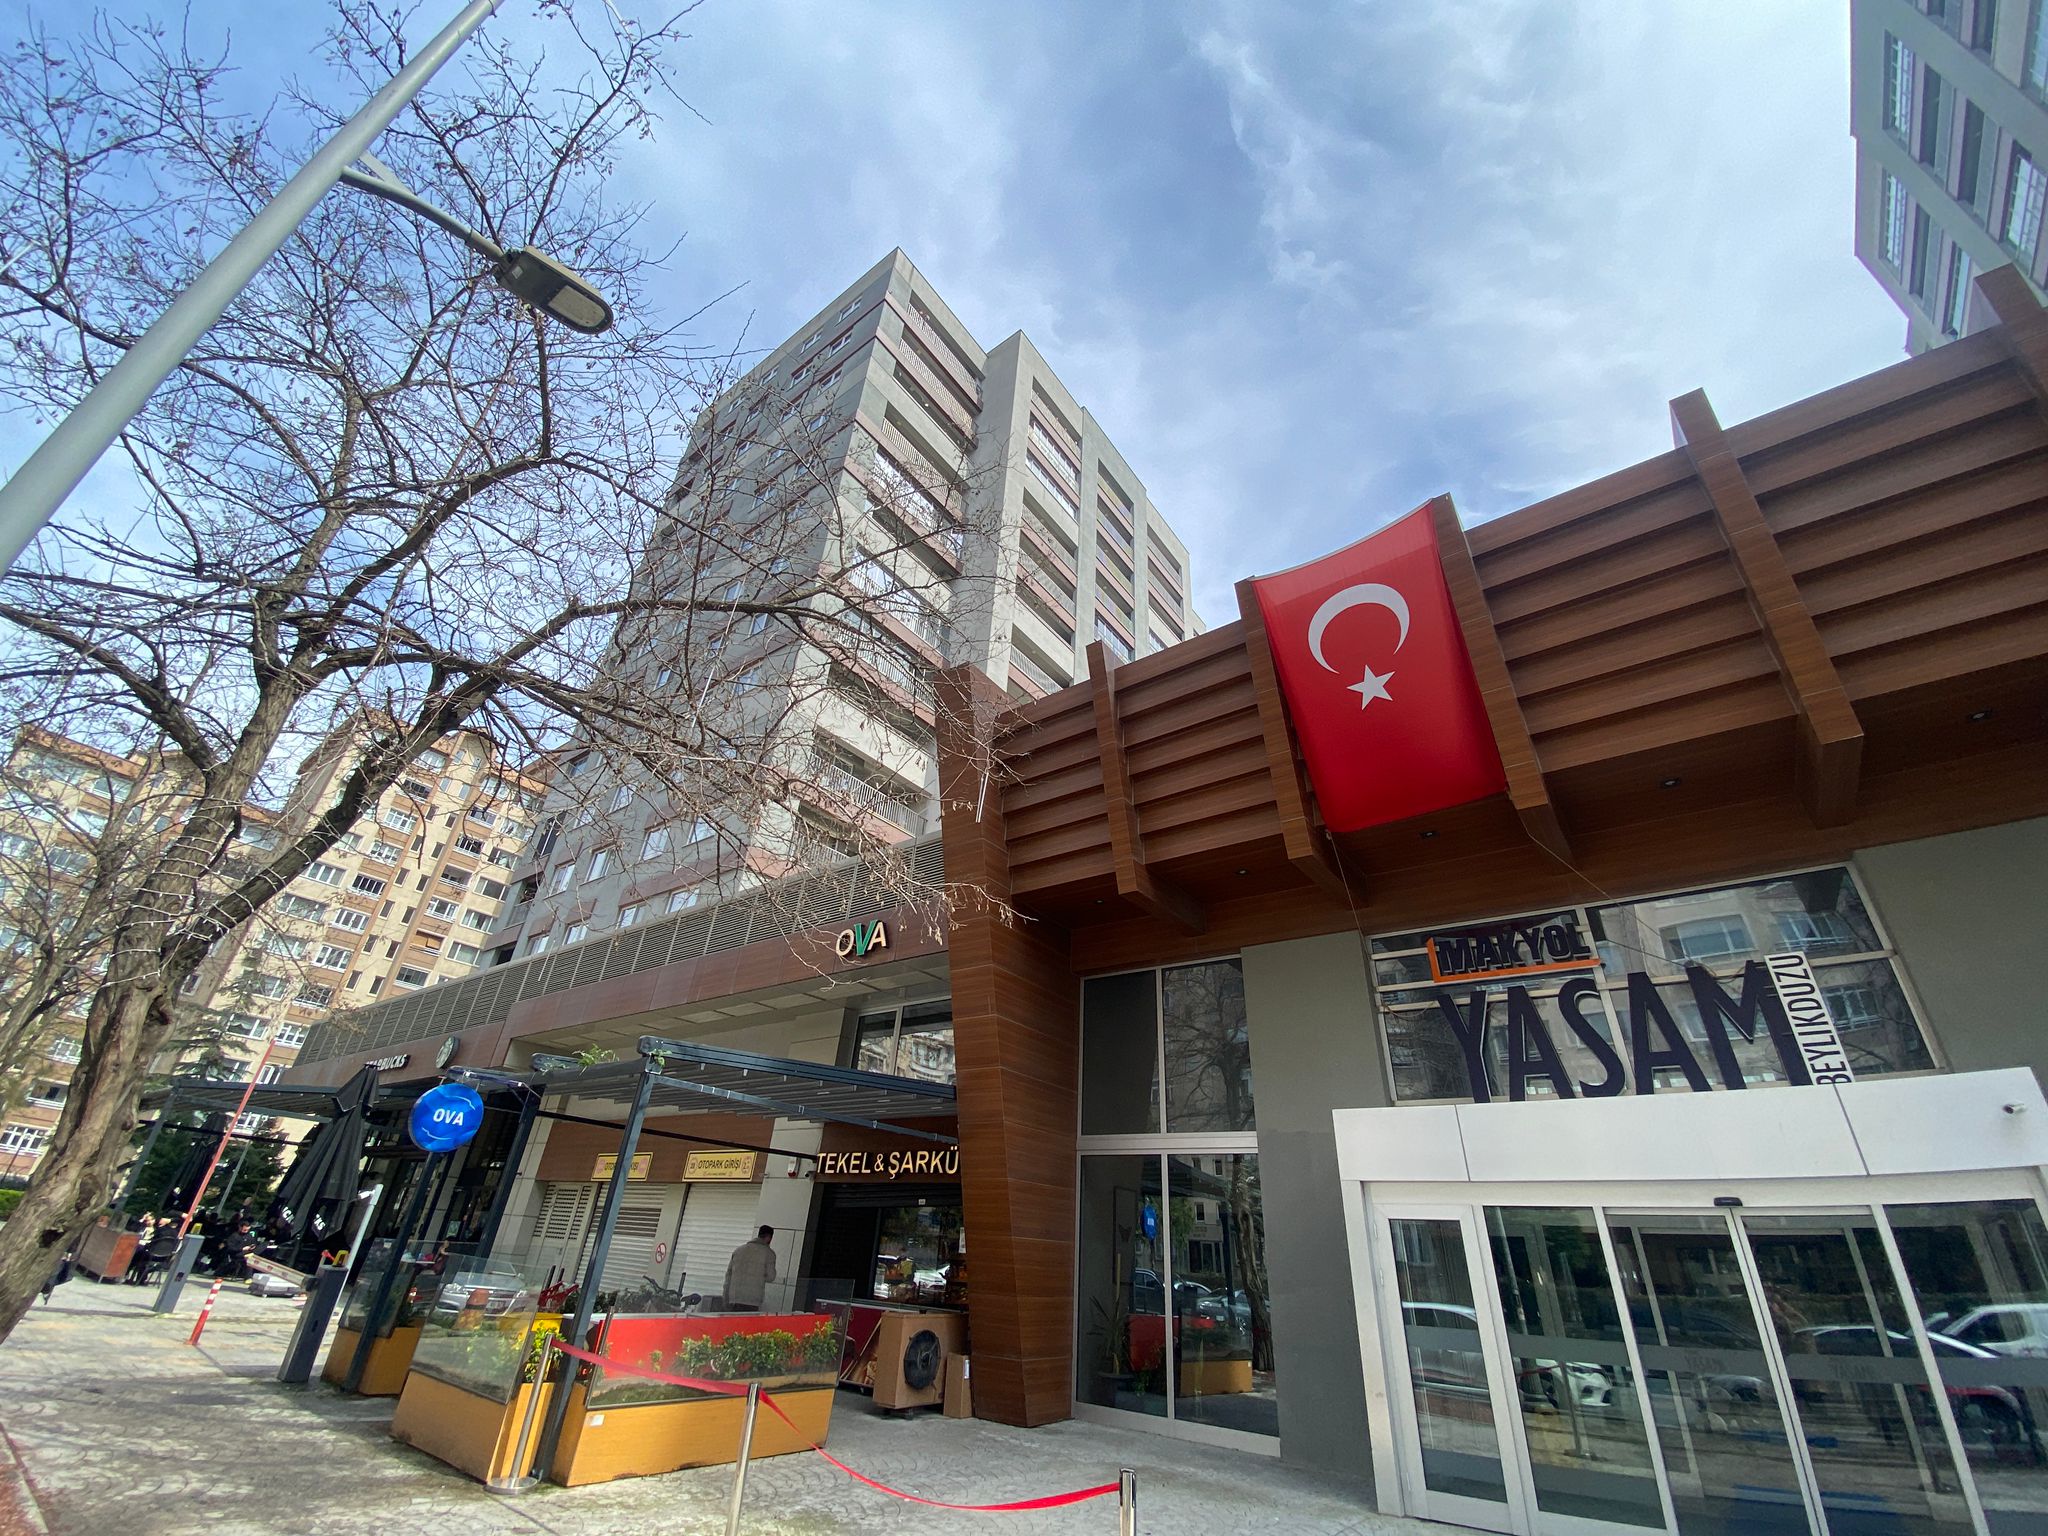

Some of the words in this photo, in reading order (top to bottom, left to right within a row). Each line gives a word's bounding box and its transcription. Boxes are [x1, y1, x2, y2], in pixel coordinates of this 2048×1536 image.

[836, 919, 887, 956] OVA
[1437, 922, 1592, 974] MAKYOL
[1769, 954, 1853, 1086] BEYLIKDUZU
[432, 1107, 465, 1127] OVA
[697, 1159, 724, 1169] OTOPARK
[816, 1151, 871, 1174] TEKEL
[873, 1153, 885, 1172] &
[888, 1145, 960, 1180] ŞARKÜ
